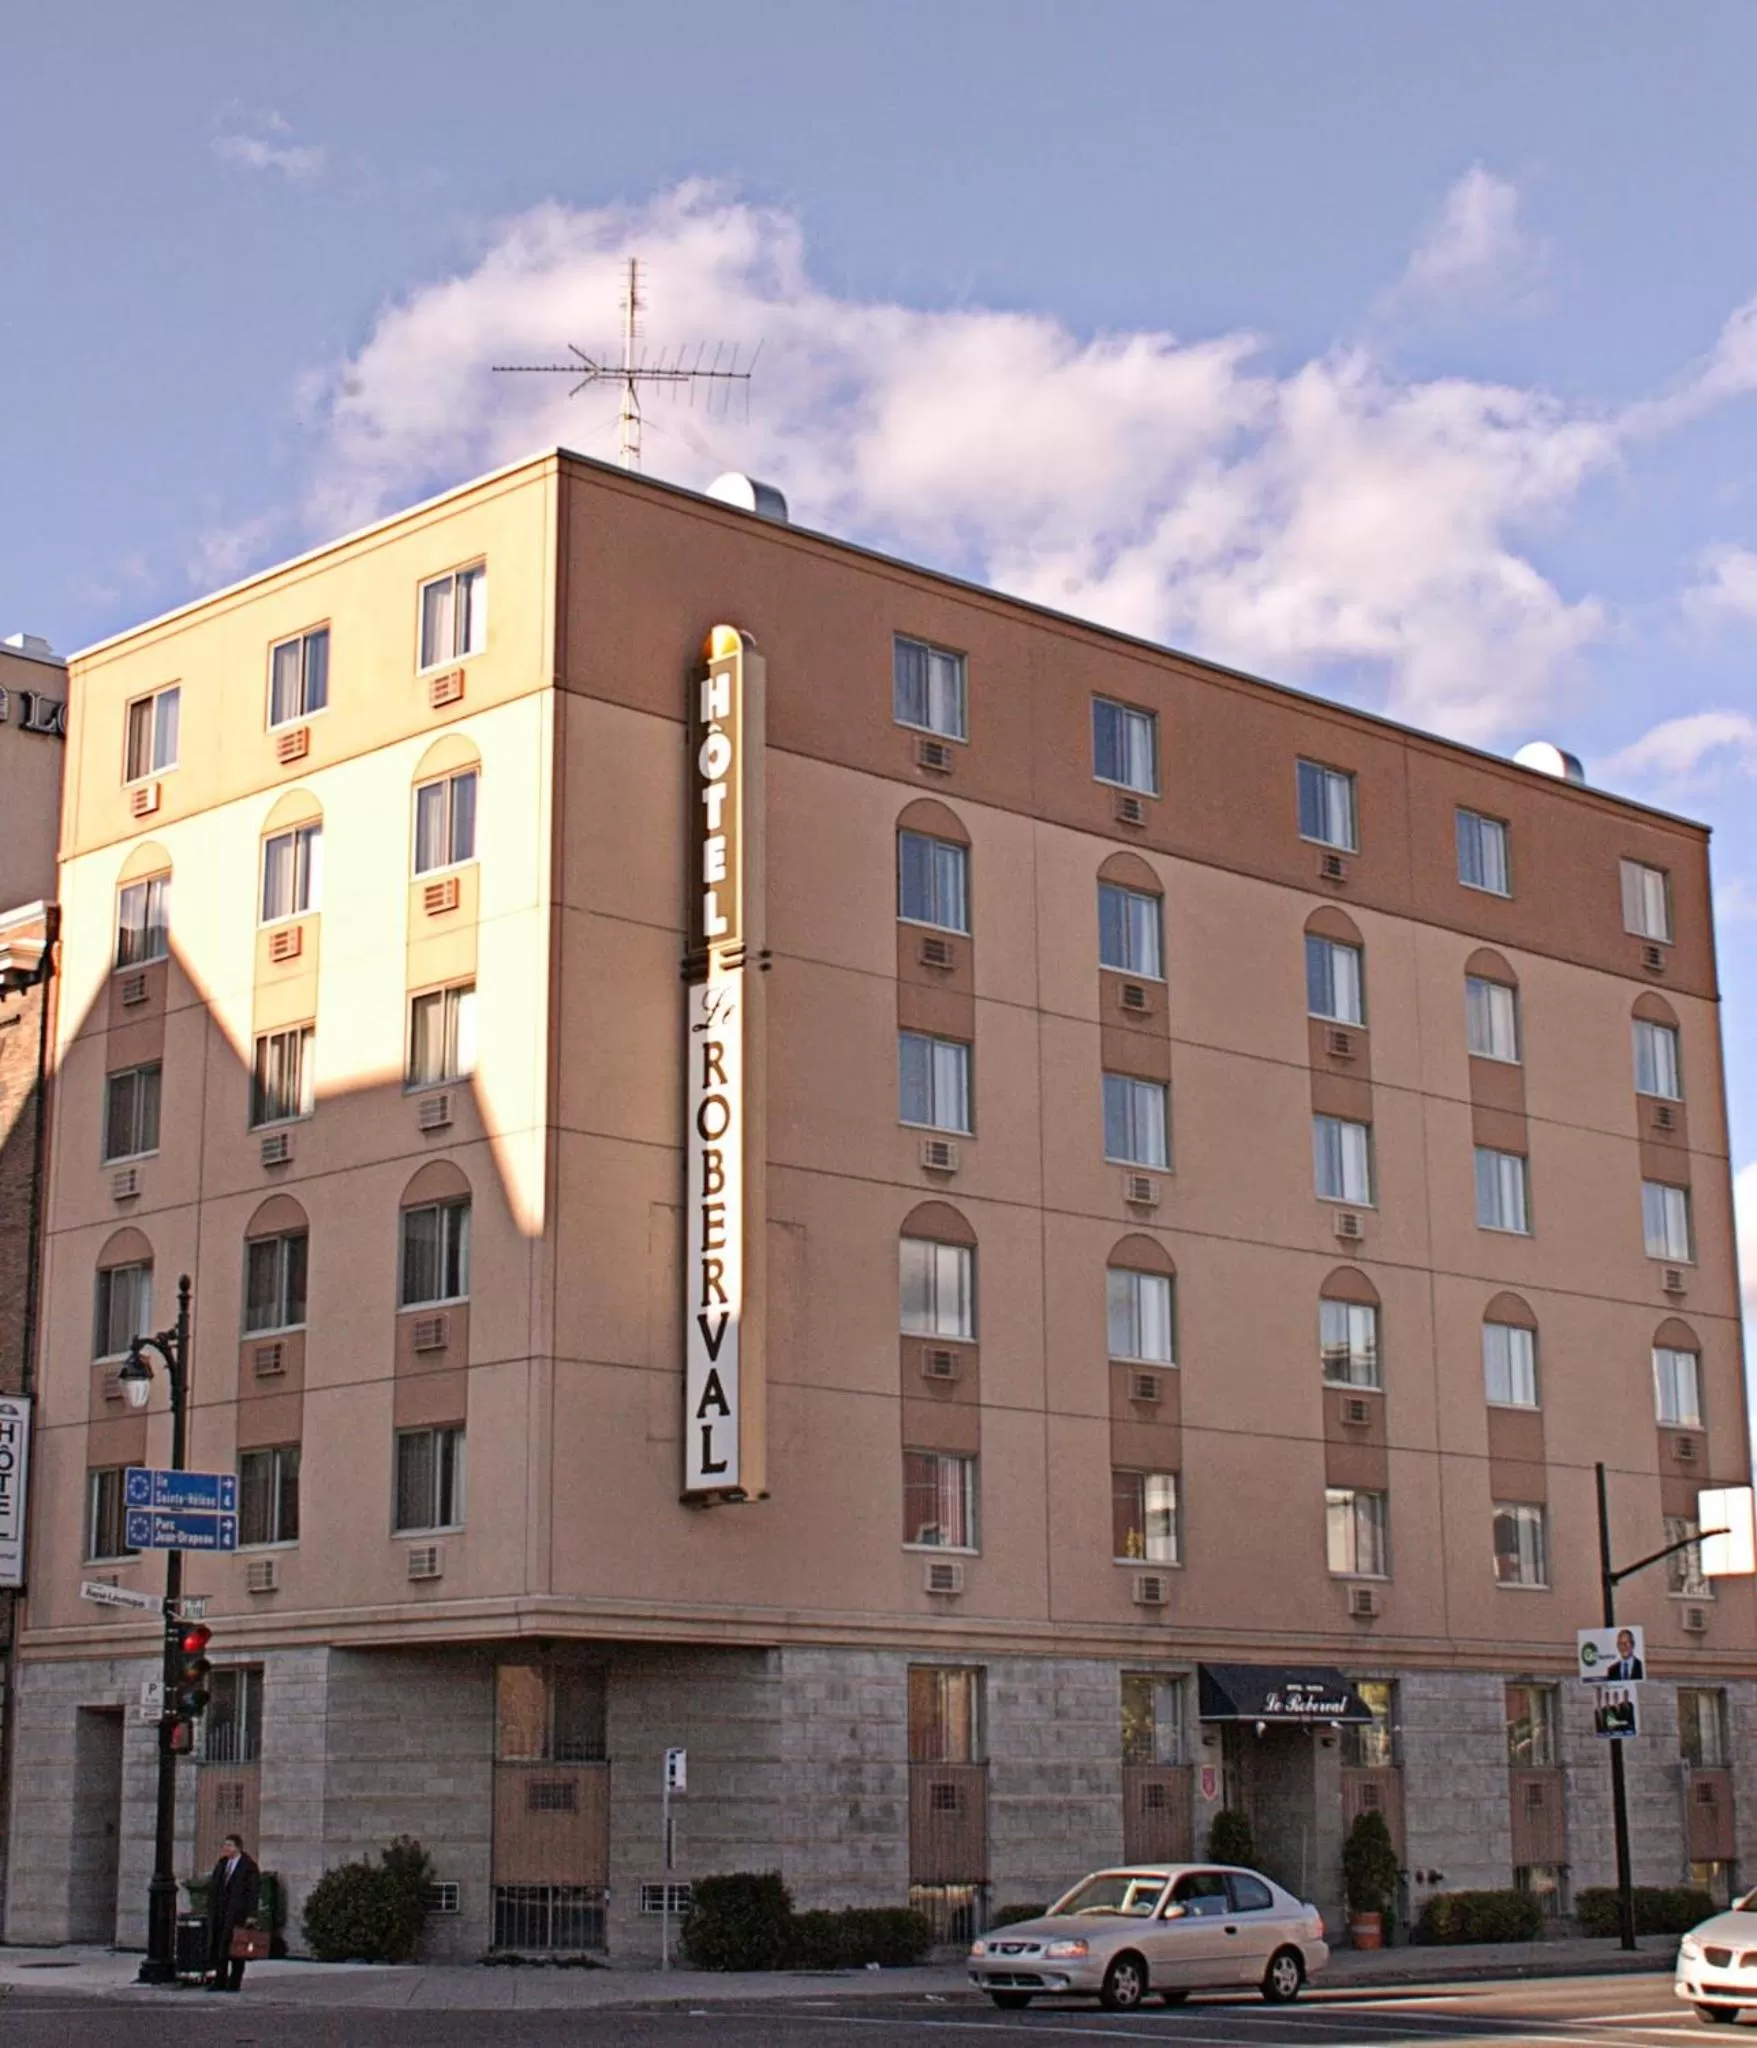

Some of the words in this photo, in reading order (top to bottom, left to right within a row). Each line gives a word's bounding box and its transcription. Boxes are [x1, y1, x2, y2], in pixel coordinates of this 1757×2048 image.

[699, 672, 732, 937] HÔTEL
[692, 985, 736, 1032] Le
[696, 1040, 732, 1475] ROBERVAL
